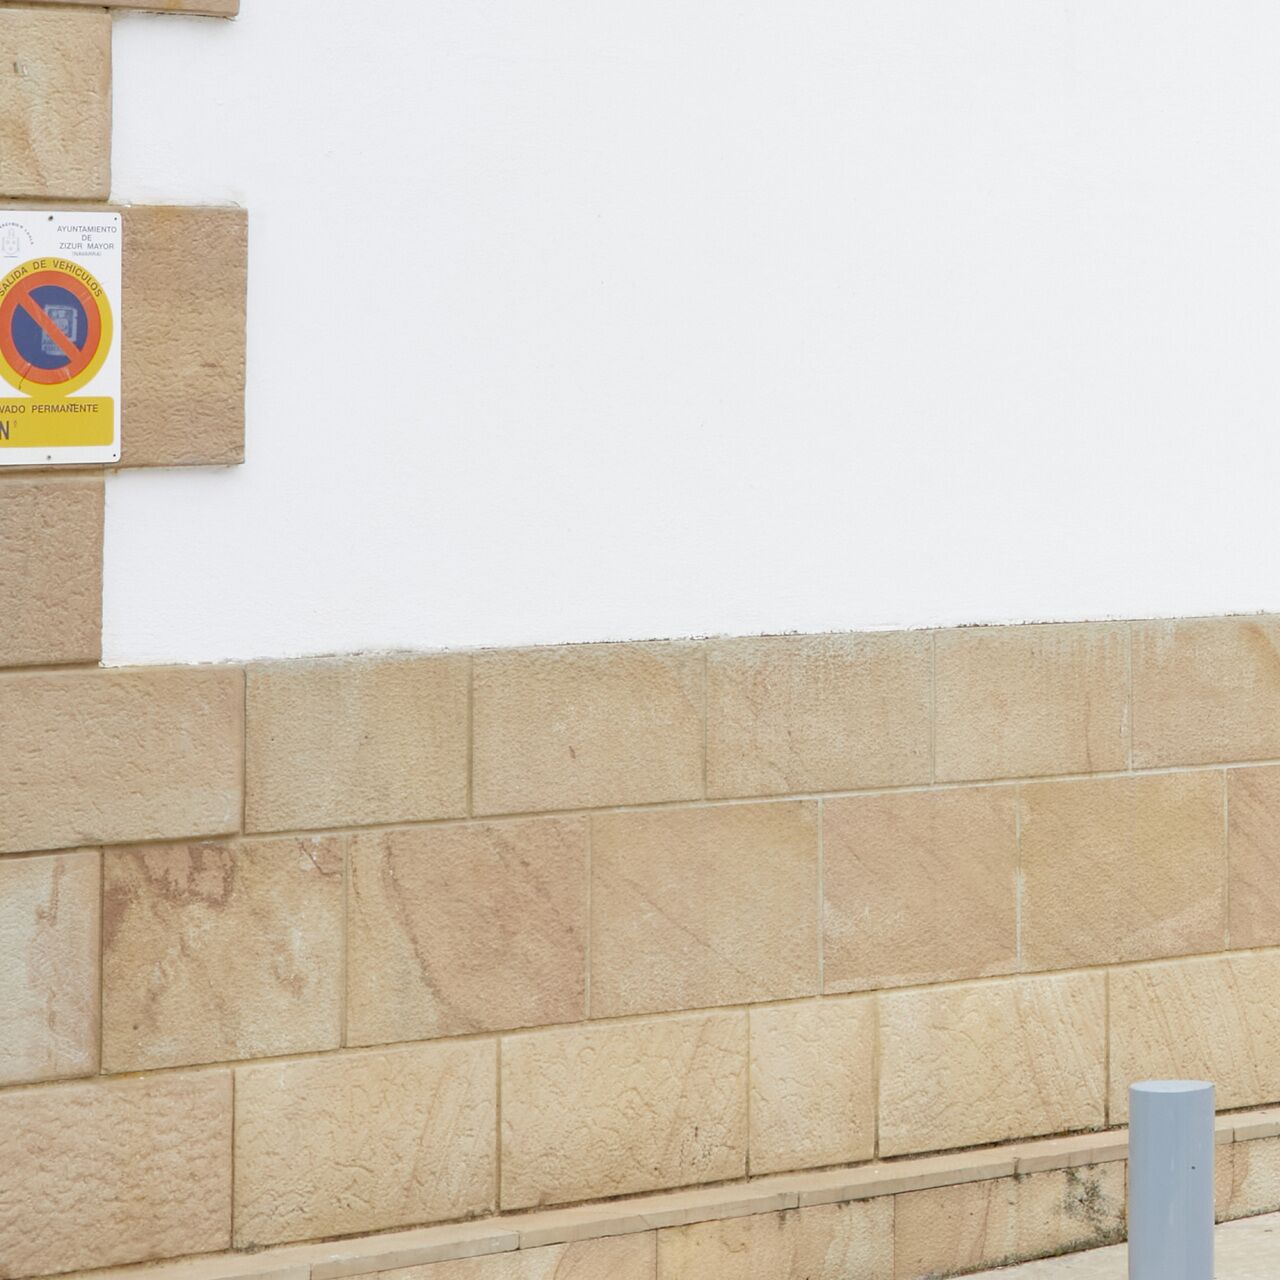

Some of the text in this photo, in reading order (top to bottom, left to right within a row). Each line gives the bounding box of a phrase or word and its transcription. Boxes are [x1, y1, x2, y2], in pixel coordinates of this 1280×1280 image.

[57, 225, 117, 233] AYUNTAMIENTO
[81, 234, 92, 242] DE
[0, 259, 103, 298] SALIDA DE VEHICULOS
[31, 404, 98, 413] PERMANENTE
